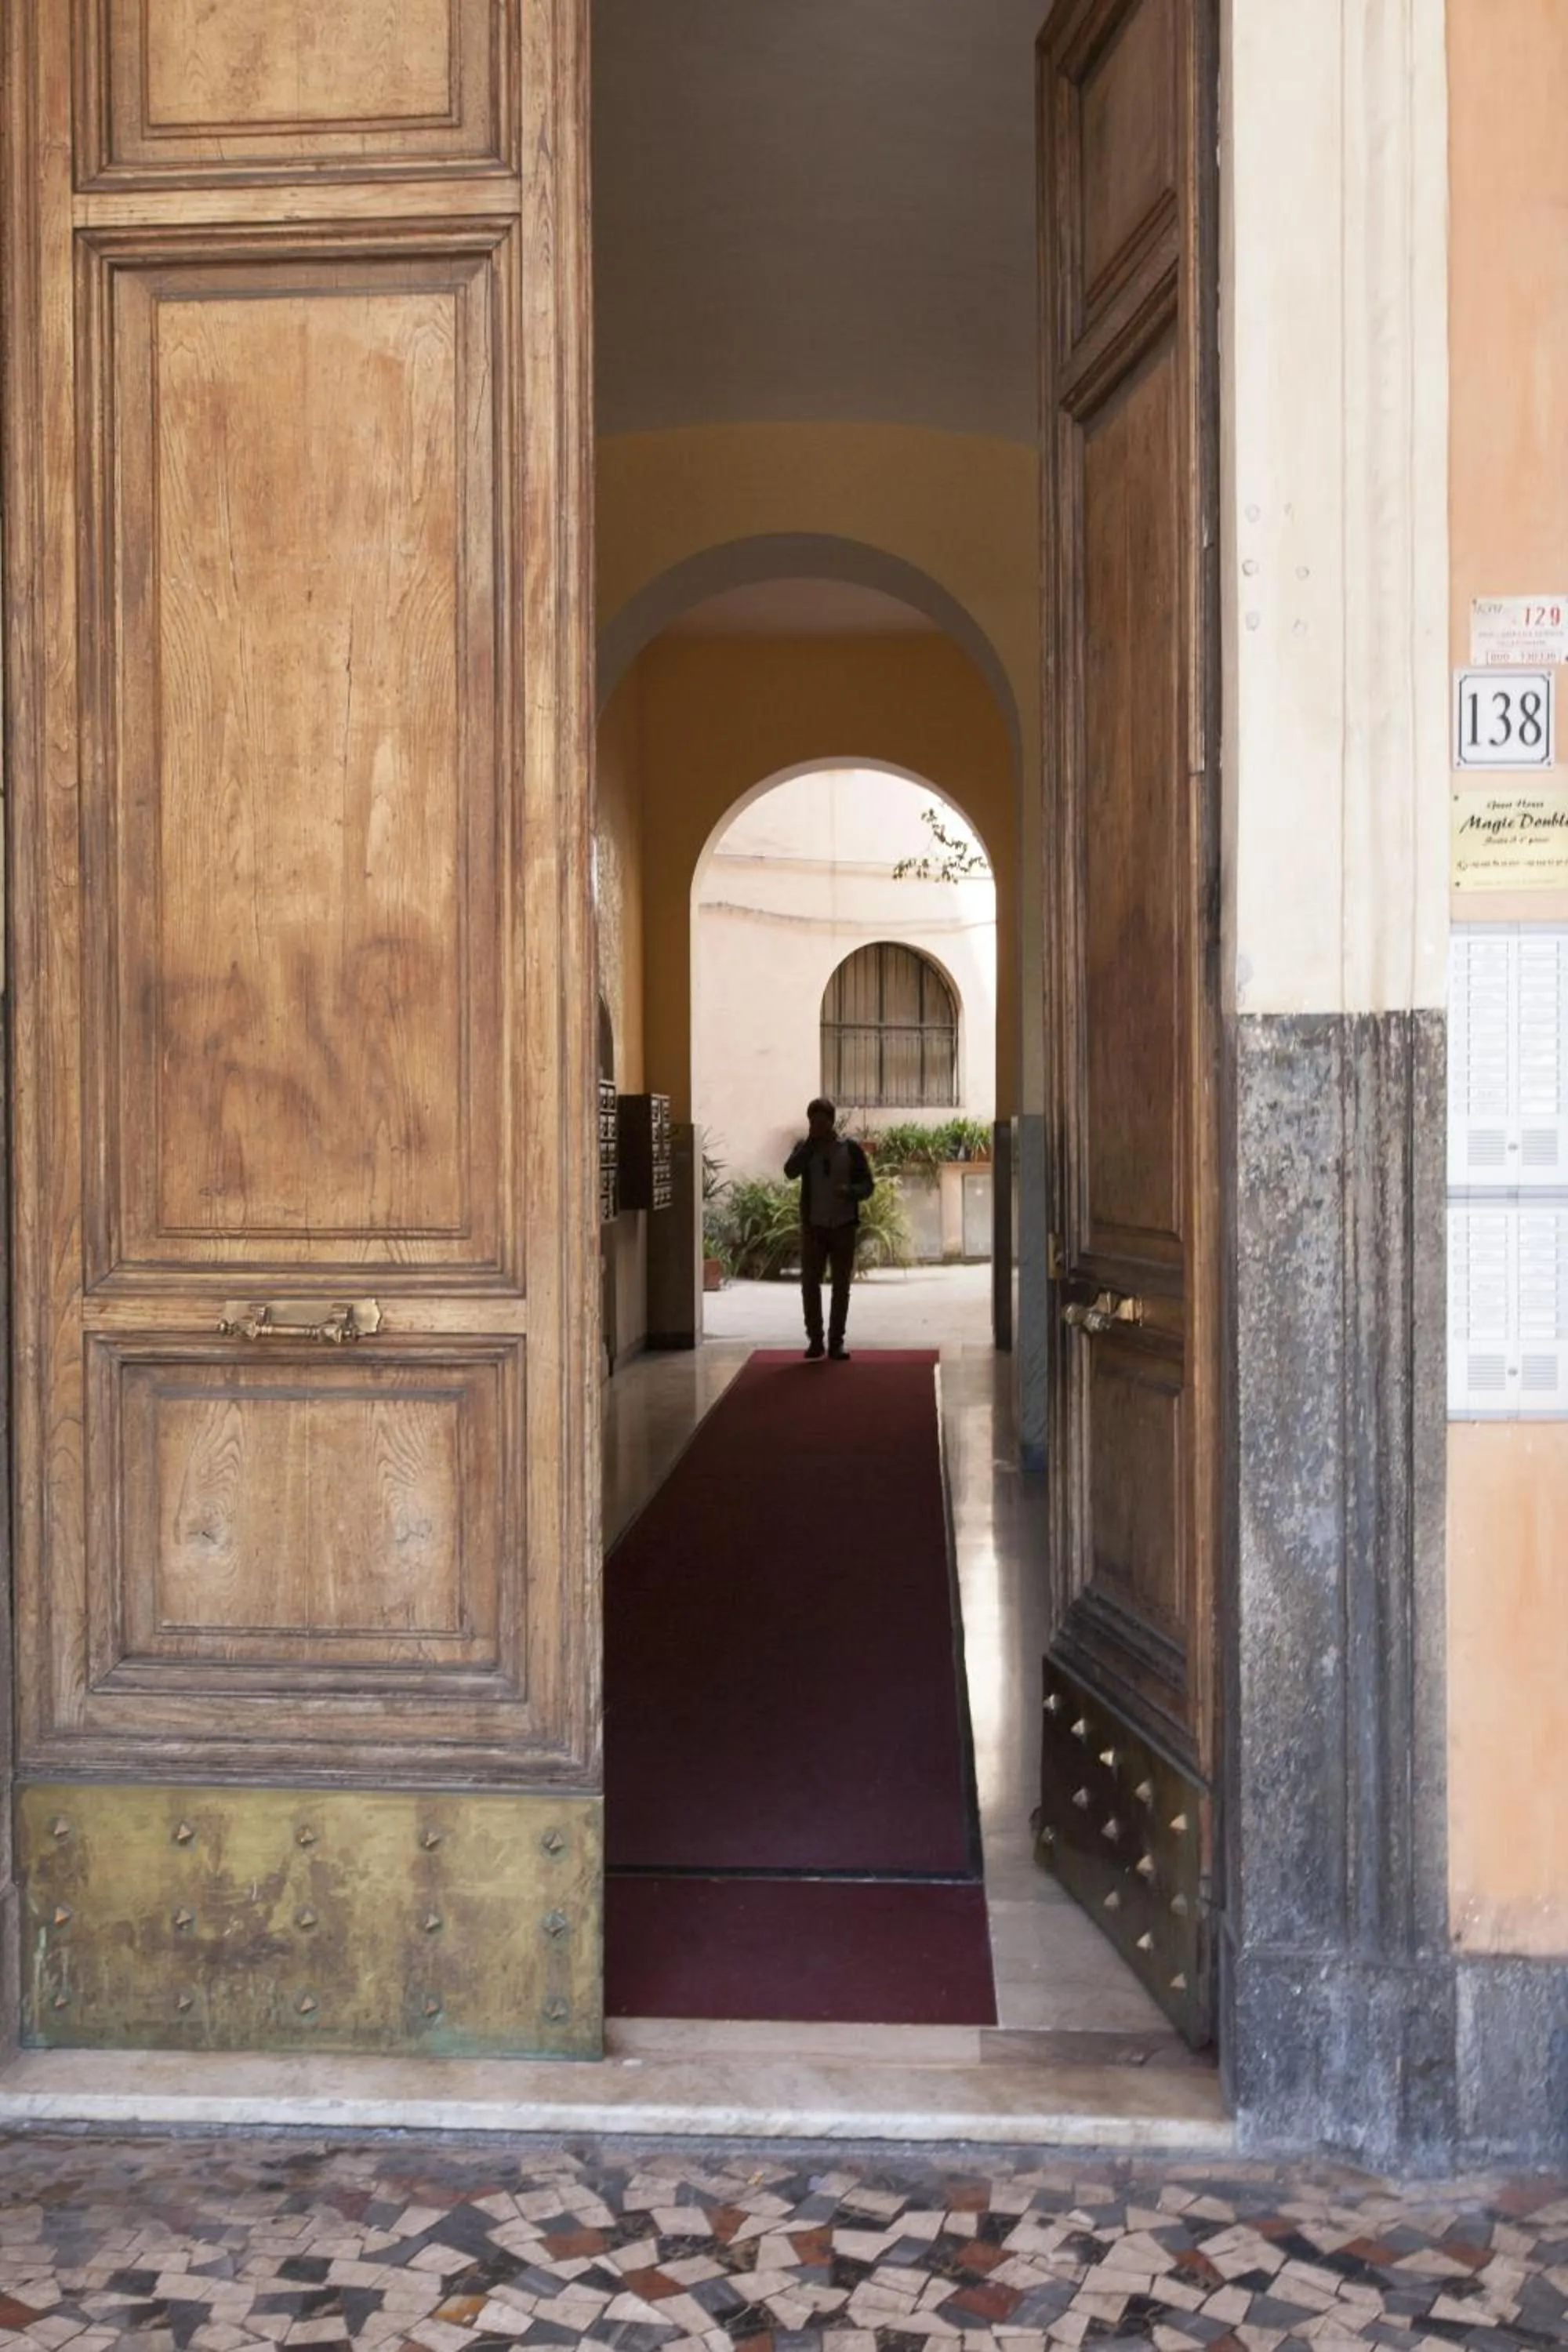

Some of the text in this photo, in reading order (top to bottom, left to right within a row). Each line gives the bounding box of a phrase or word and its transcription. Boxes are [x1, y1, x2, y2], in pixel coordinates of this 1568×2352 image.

[1525, 604, 1561, 626] 129
[1467, 691, 1542, 747] 138
[1459, 814, 1515, 835] Magic
